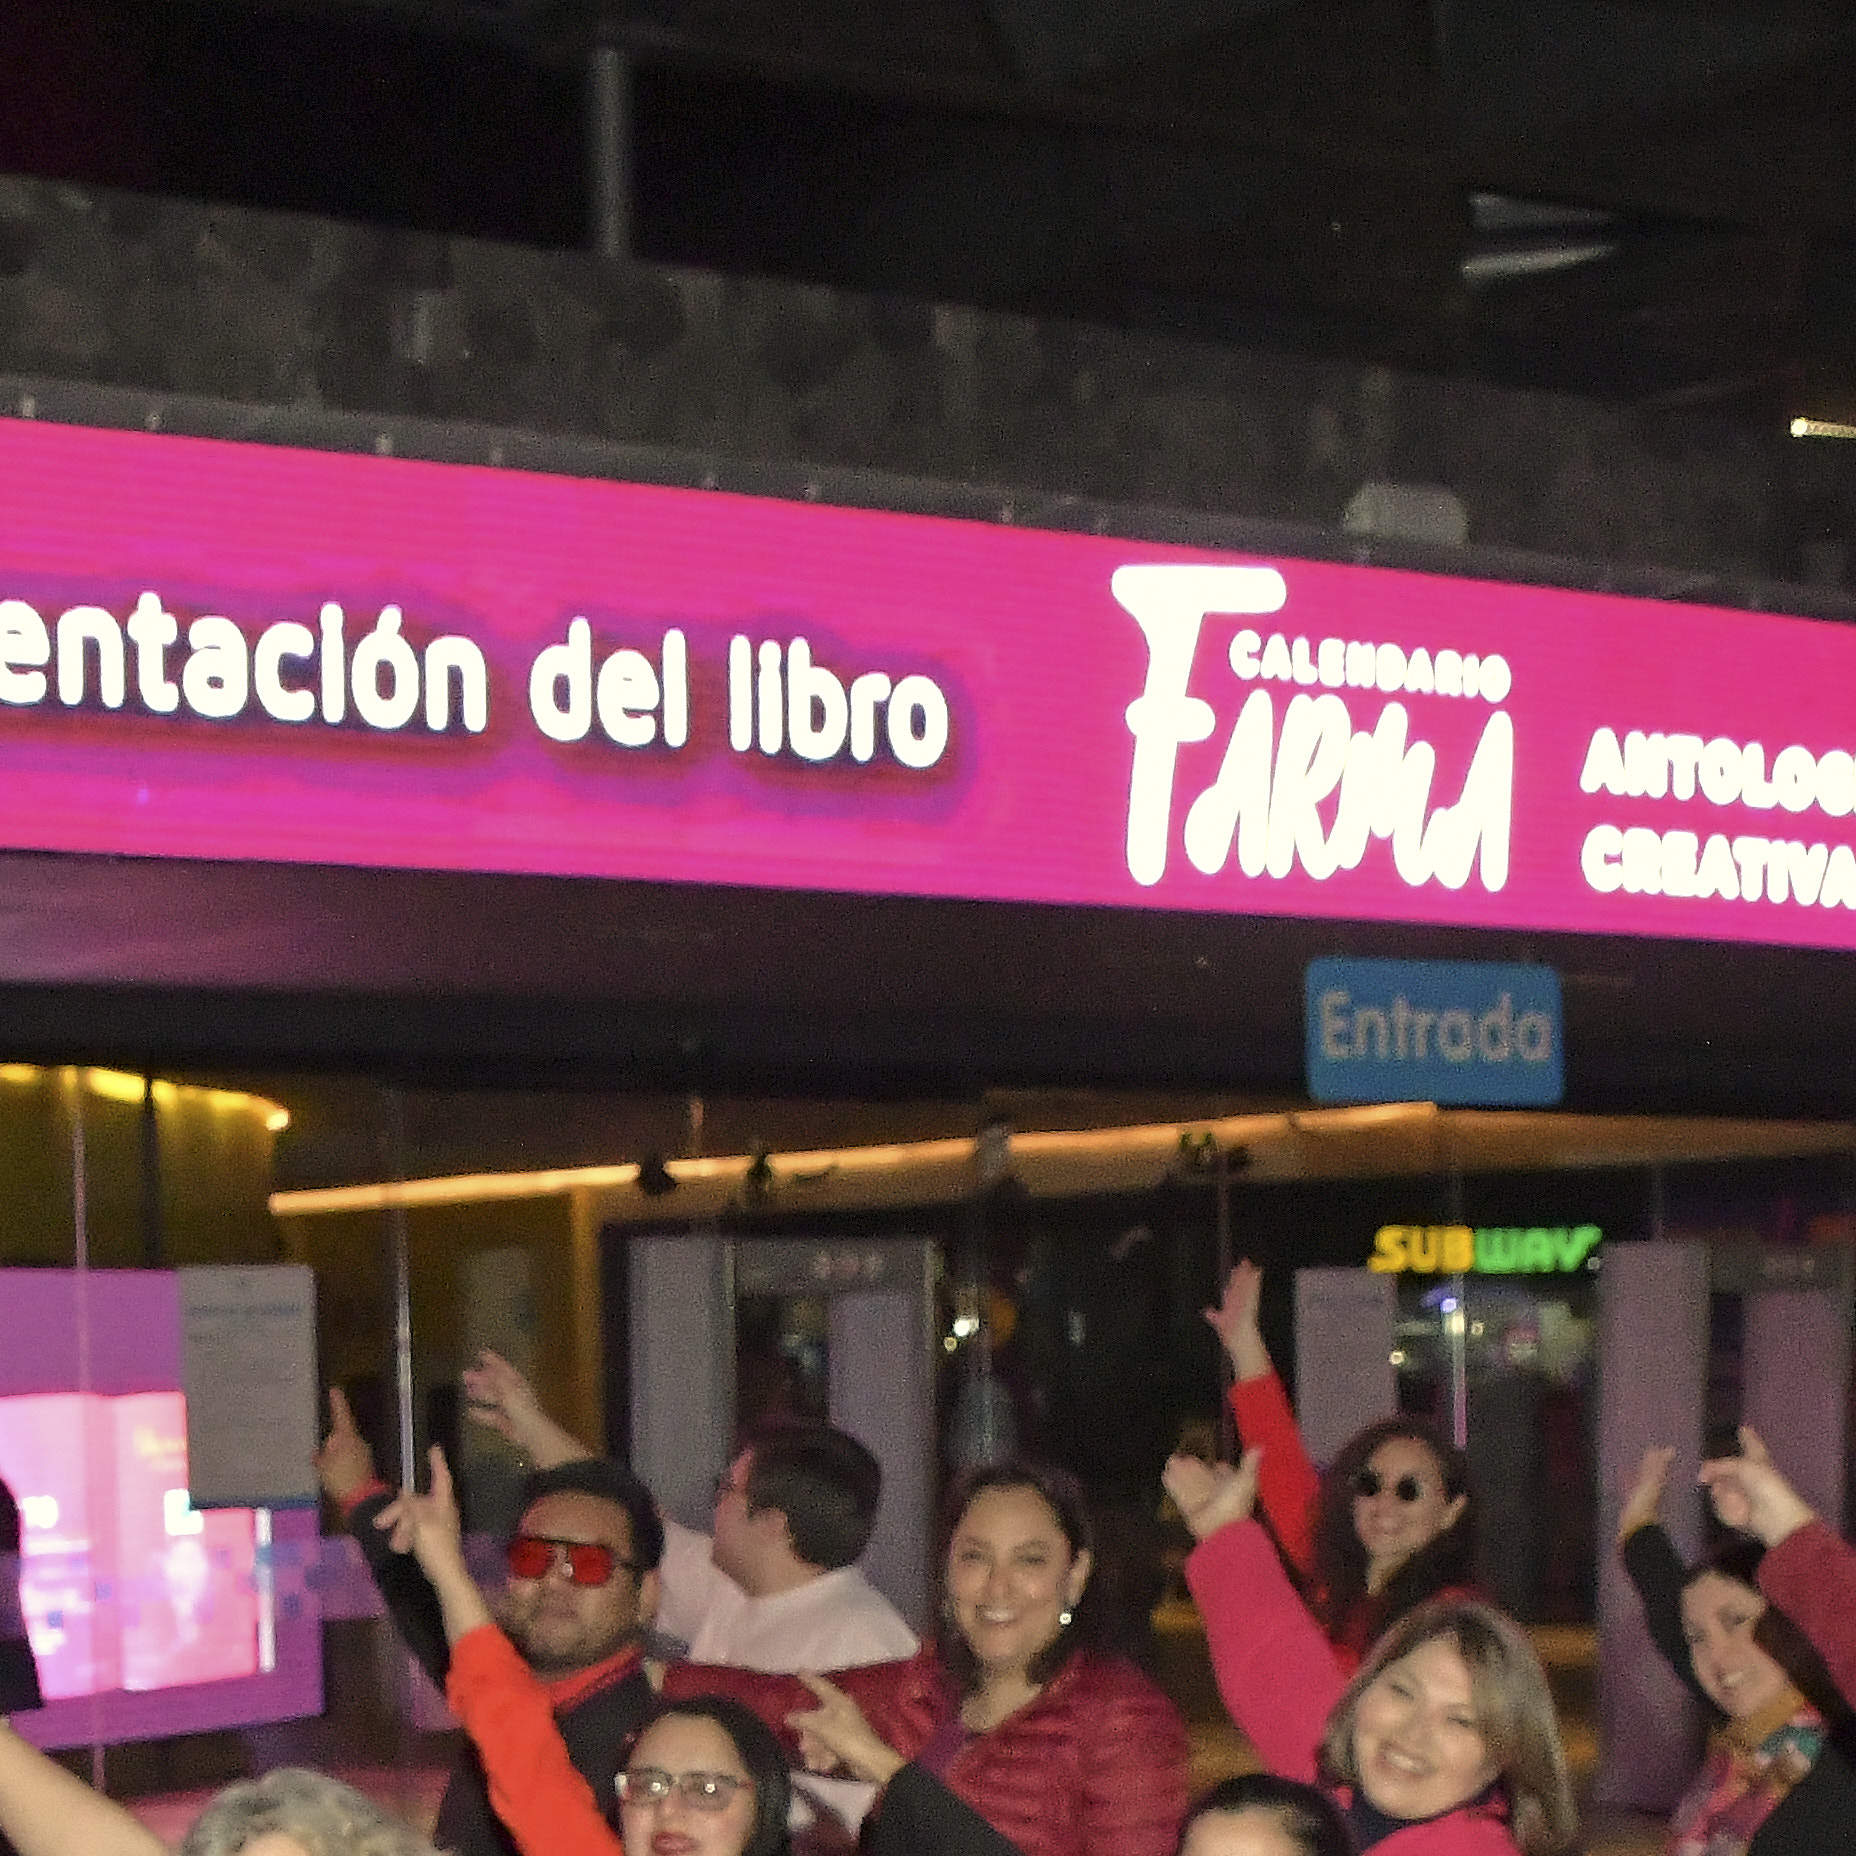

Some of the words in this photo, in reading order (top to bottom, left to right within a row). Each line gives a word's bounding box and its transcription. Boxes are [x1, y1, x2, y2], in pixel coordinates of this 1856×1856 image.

[528, 616, 689, 749] del
[728, 634, 949, 769] libro
[1228, 630, 1513, 704] CALENDARIO
[1110, 564, 1515, 893] FARMA
[1320, 988, 1554, 1064] Entrada
[1366, 1223, 1604, 1275] SUBWAY
